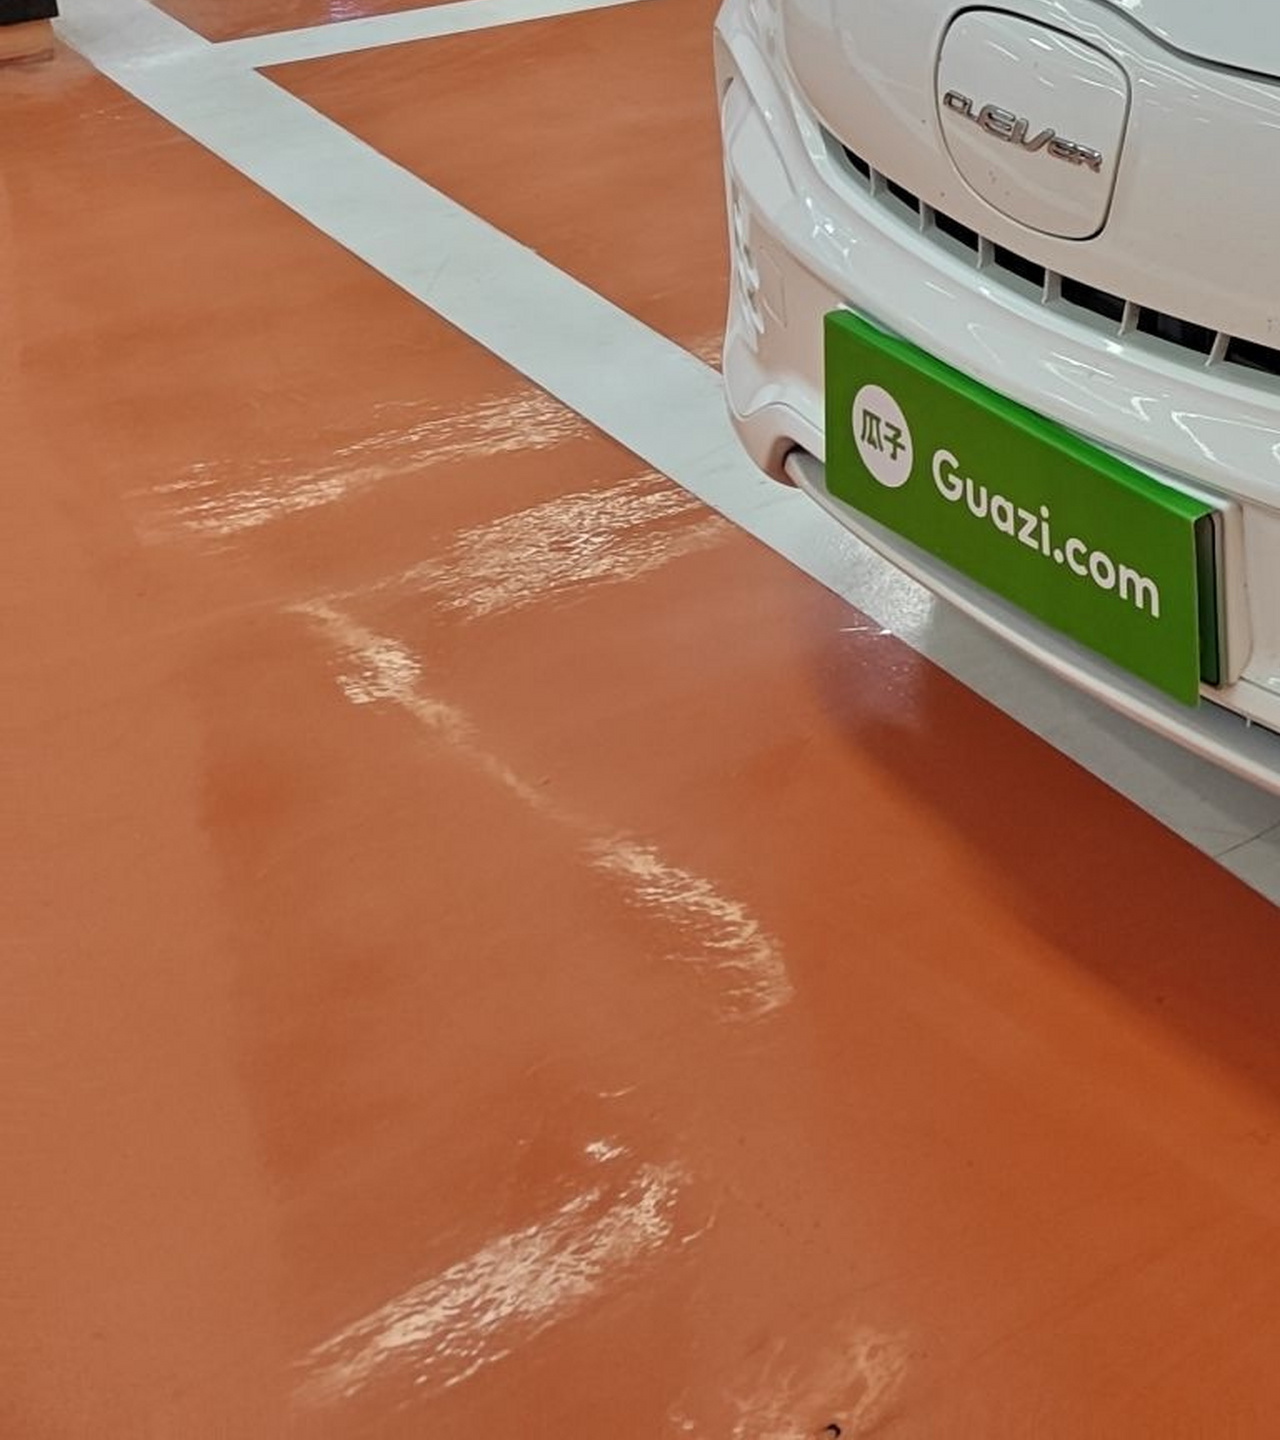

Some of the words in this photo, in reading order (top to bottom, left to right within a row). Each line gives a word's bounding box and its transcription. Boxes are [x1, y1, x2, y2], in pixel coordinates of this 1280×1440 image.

[943, 90, 1103, 173] CLEVER
[861, 409, 906, 460] 瓜子
[932, 449, 1160, 619] Guazi.com
